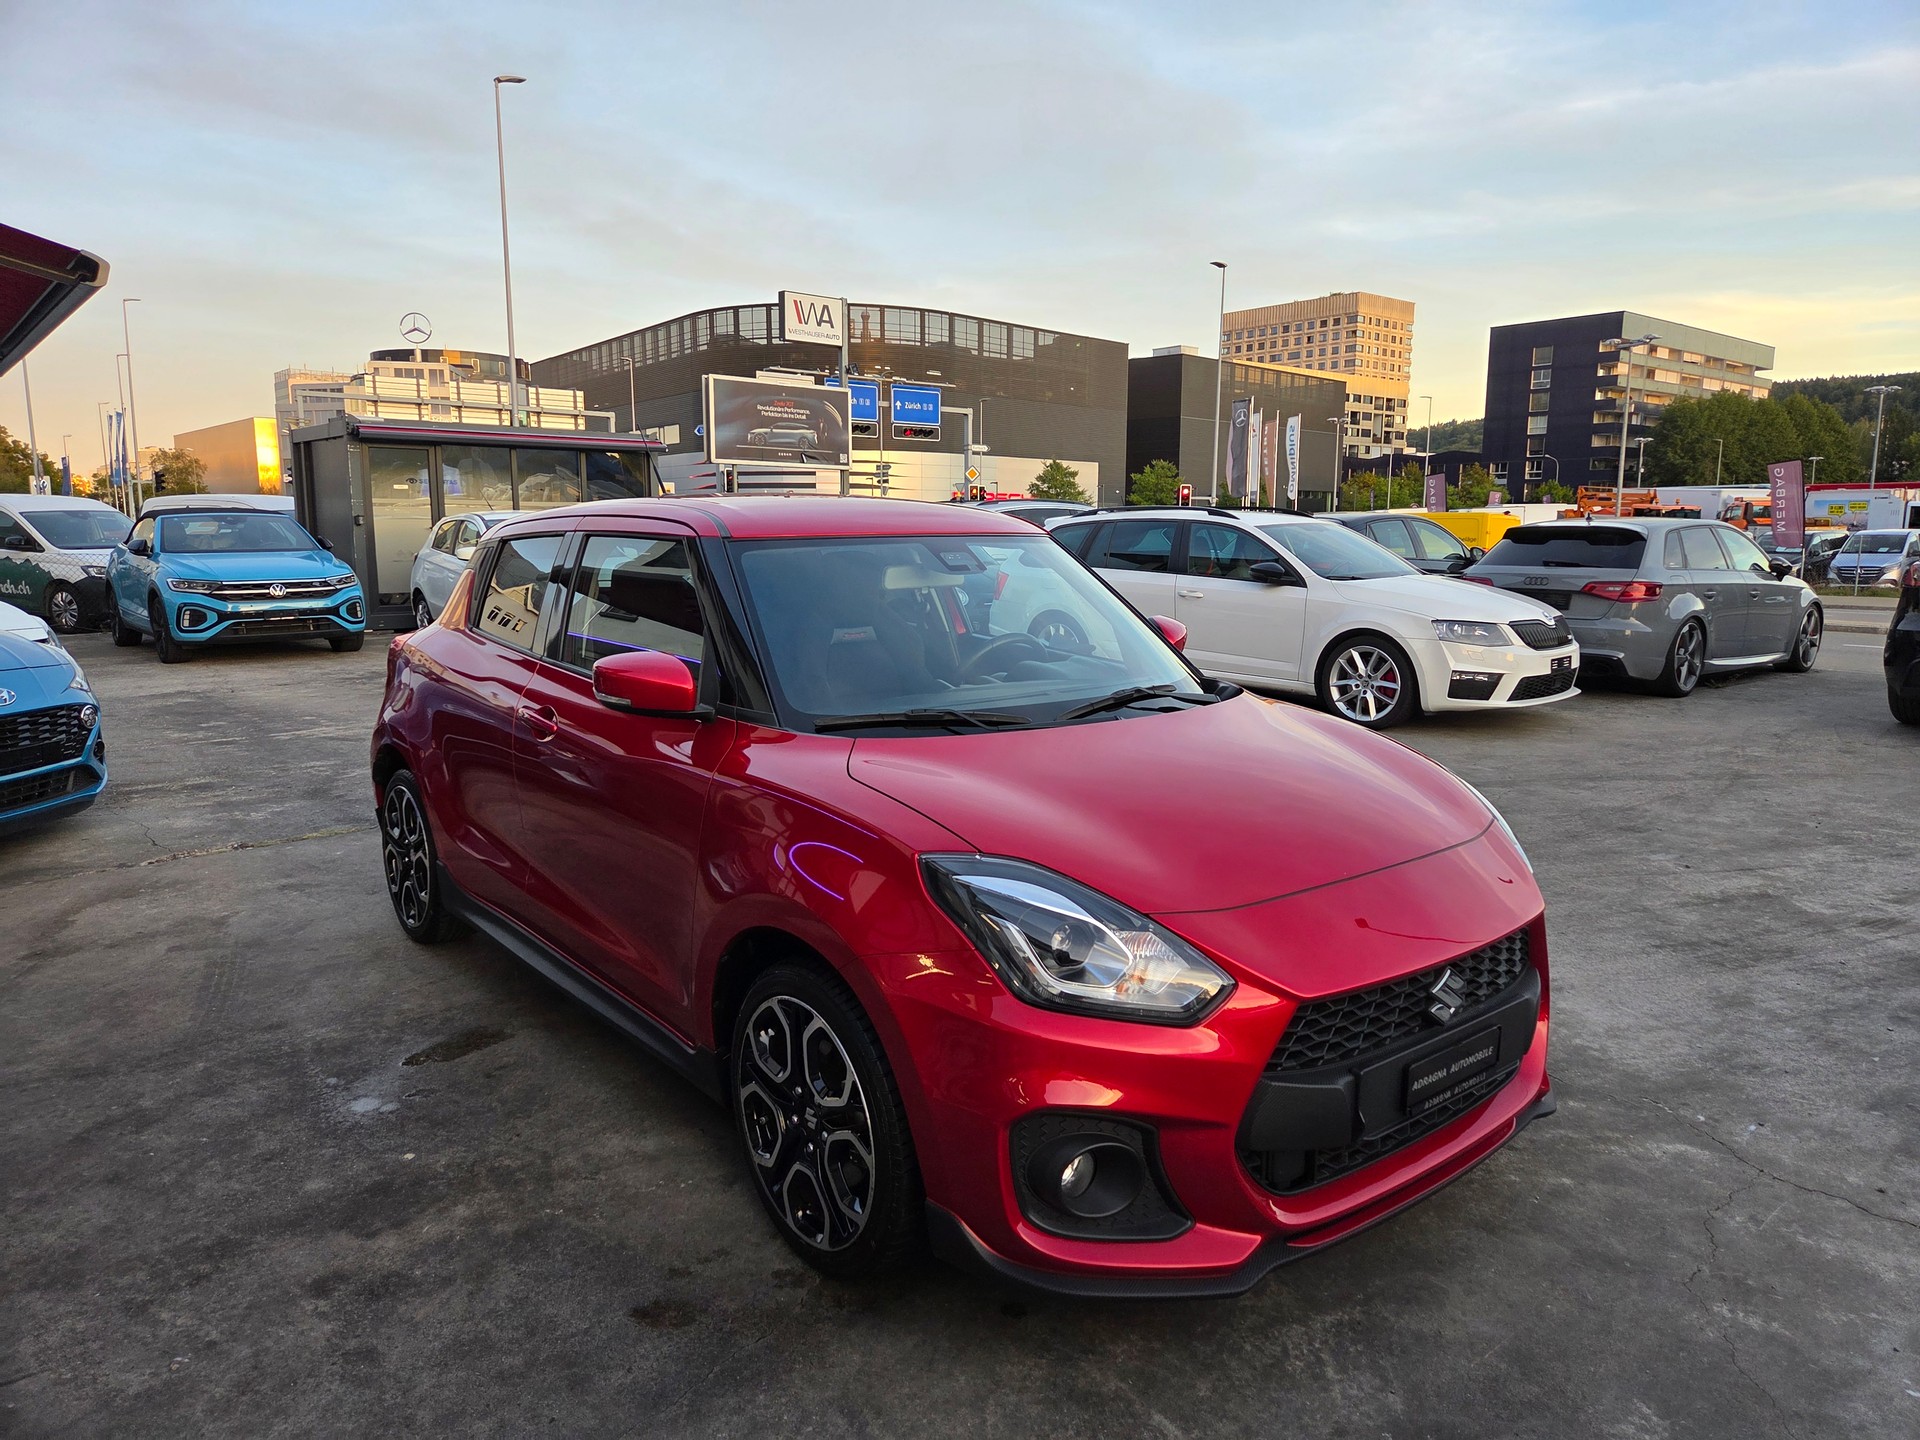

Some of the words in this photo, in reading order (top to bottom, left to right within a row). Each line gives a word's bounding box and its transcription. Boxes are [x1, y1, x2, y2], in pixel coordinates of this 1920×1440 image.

[904, 401, 921, 410] Zürich
[1412, 1068, 1447, 1091] ADRAGNA
[1449, 1046, 1494, 1073] AUTOMOBILE
